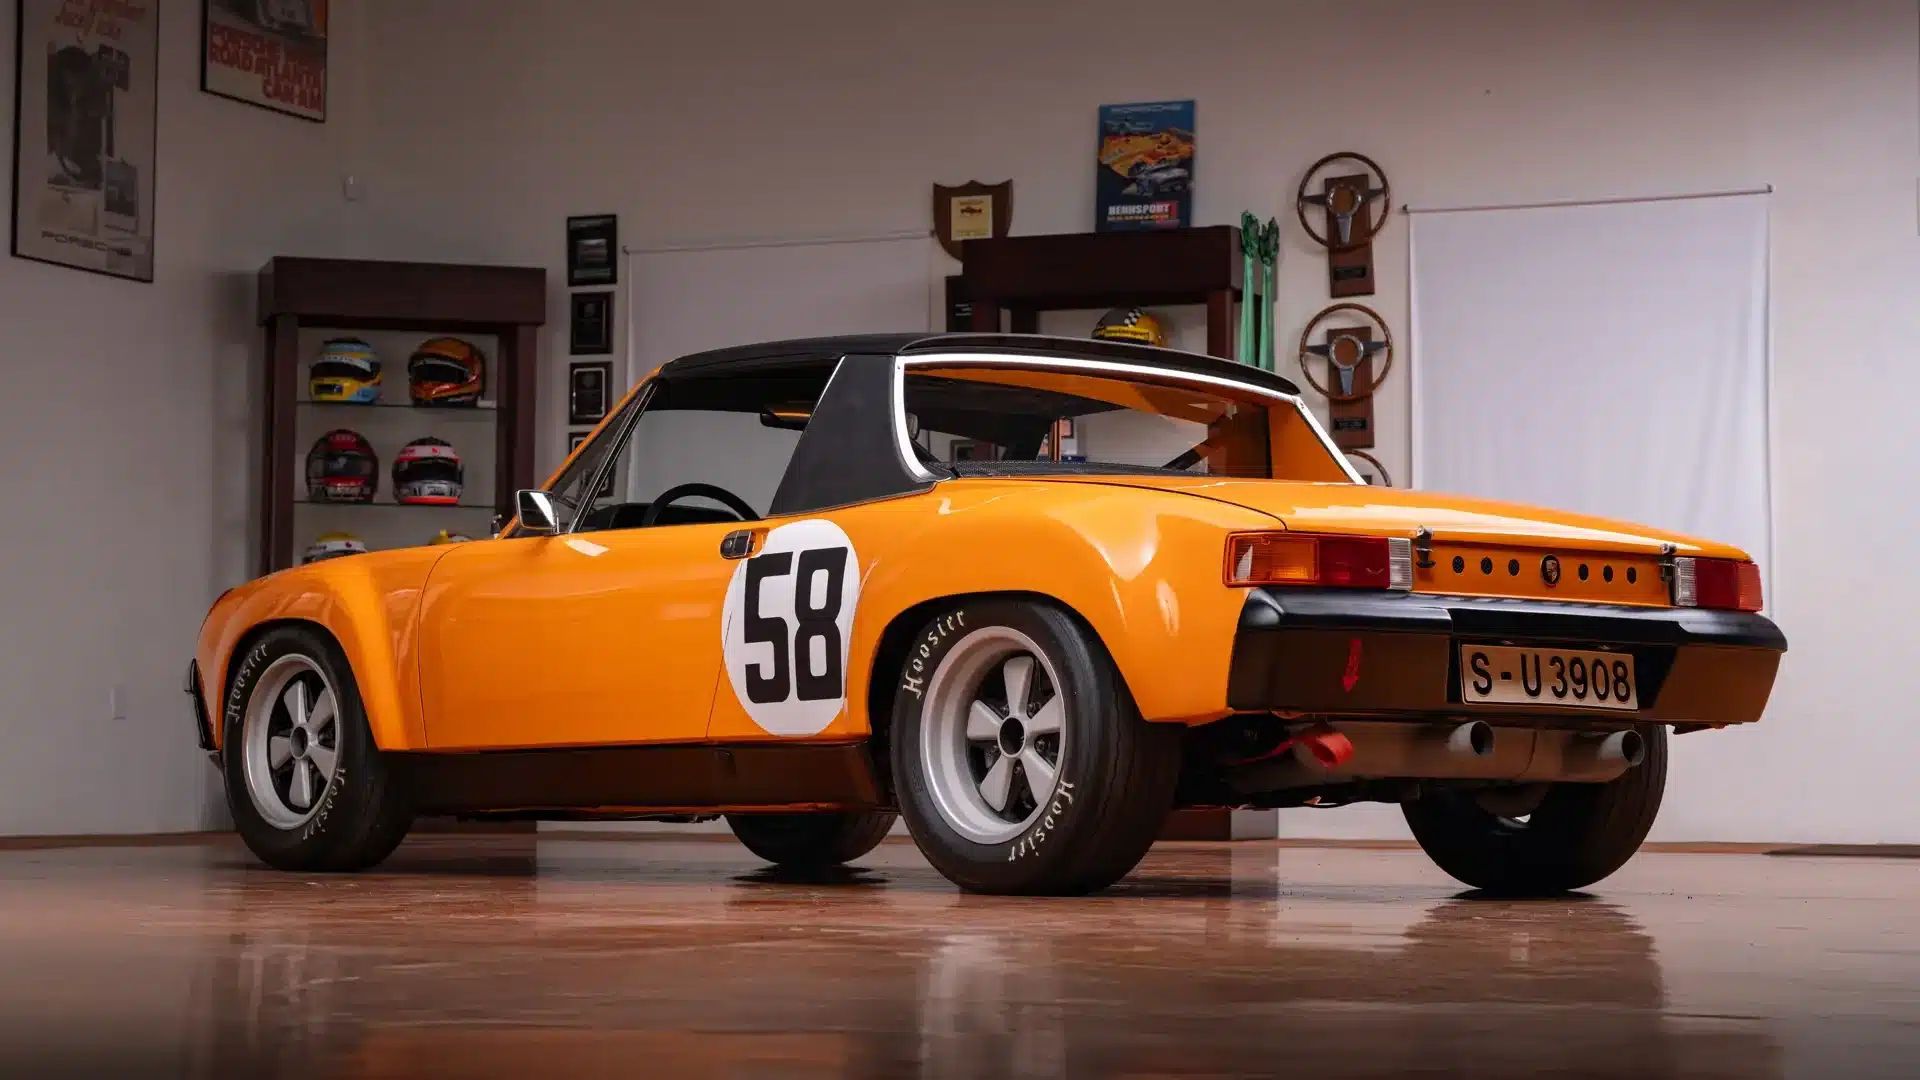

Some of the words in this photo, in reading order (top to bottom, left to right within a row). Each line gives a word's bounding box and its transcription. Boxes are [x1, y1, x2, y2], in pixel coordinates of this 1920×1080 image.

[41, 229, 133, 257] PORSCHE
[743, 546, 849, 704] 58
[903, 609, 966, 701] Hoosier
[227, 643, 268, 724] Hoosier
[302, 767, 347, 842] Hoosier
[1007, 778, 1076, 863] Hoosier
